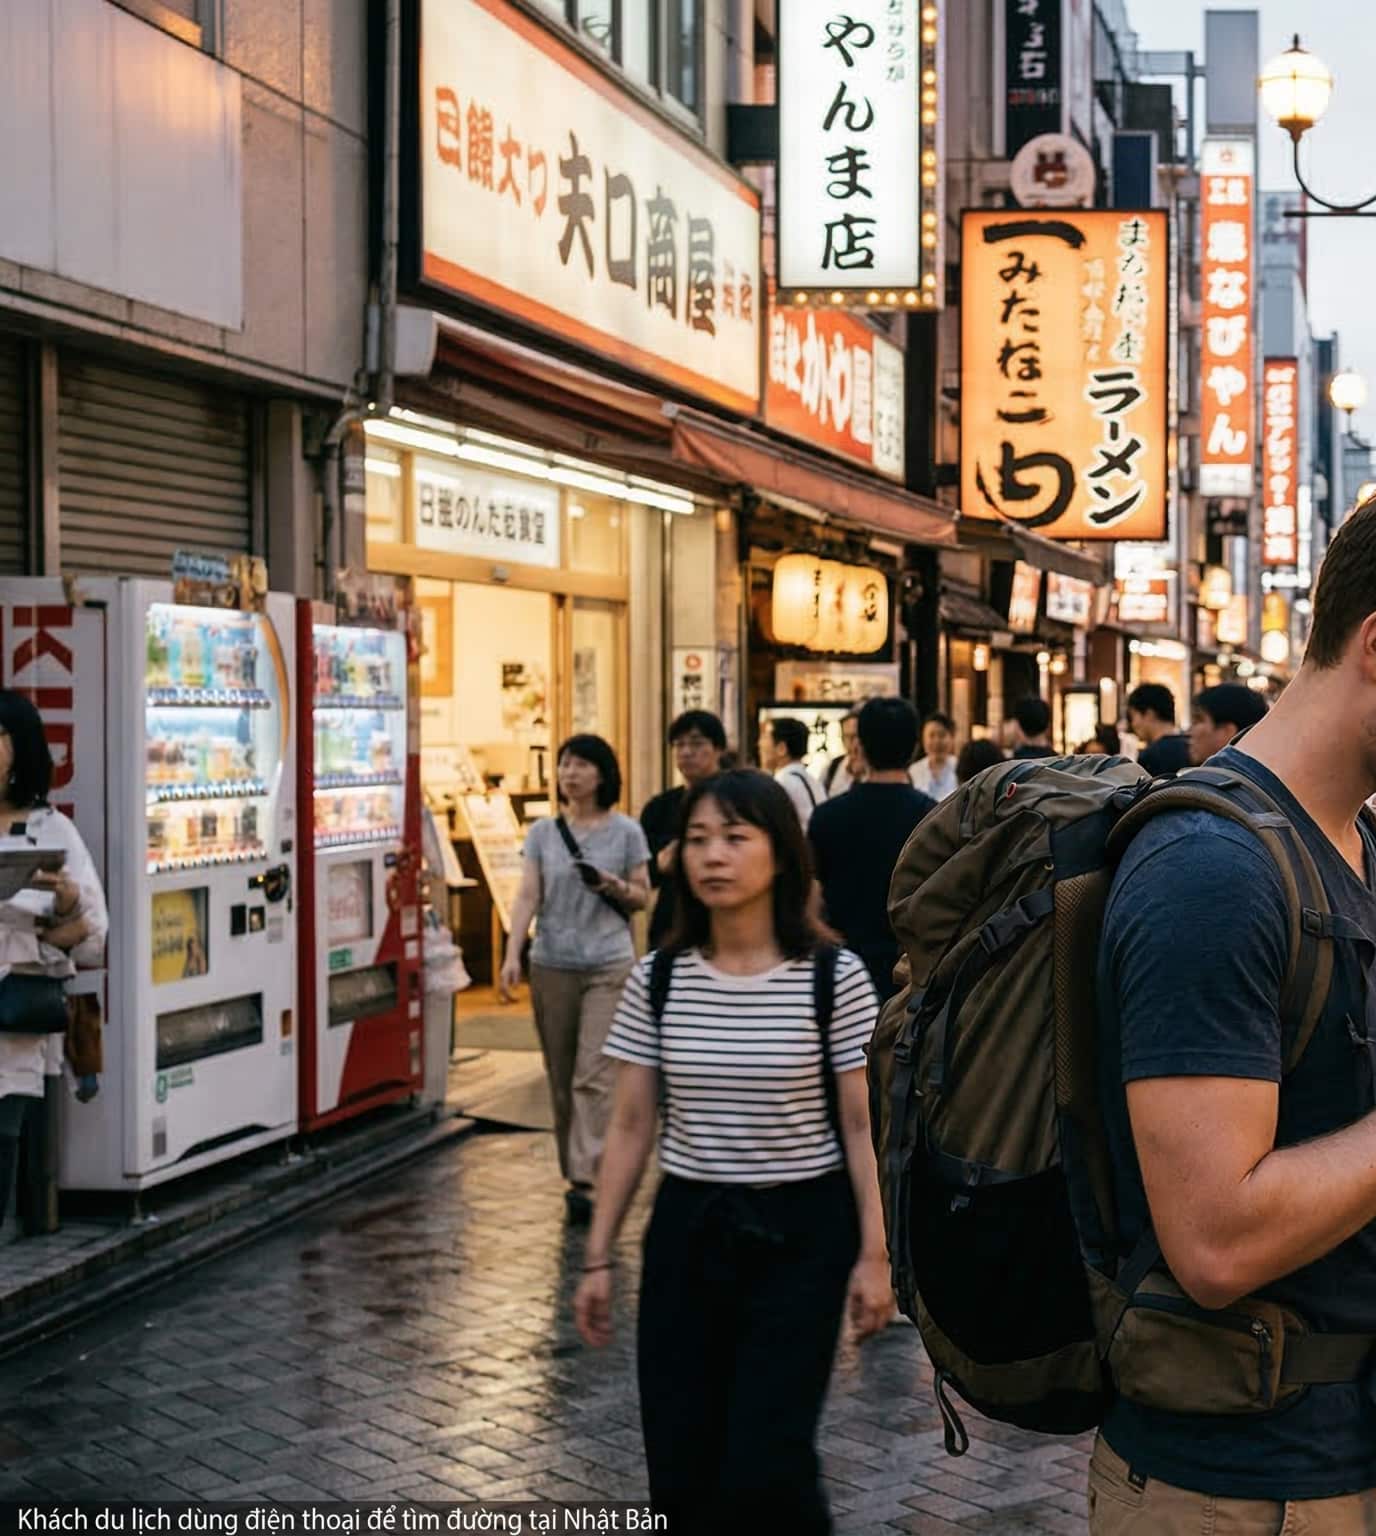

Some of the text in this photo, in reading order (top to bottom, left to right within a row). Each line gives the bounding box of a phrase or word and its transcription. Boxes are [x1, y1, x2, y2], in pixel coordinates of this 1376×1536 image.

[821, 14, 877, 270] やんま店
[1086, 371, 1143, 524] ラーメン
